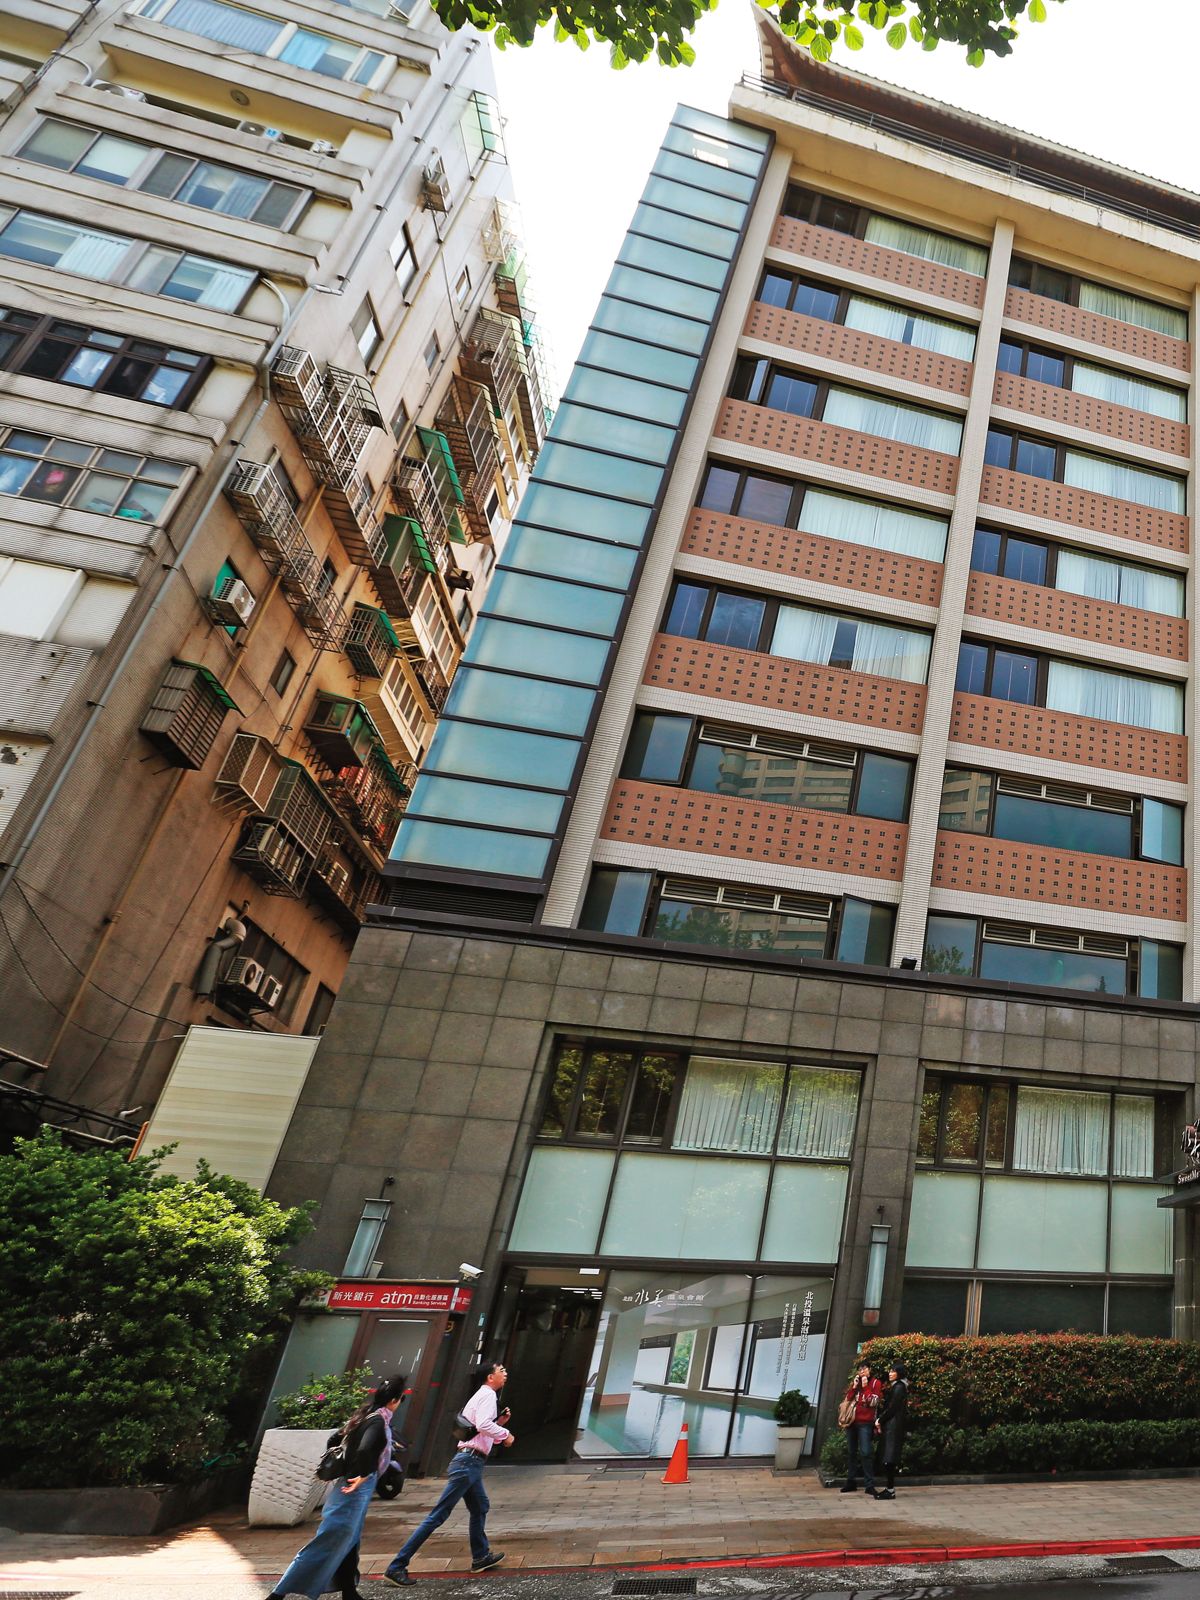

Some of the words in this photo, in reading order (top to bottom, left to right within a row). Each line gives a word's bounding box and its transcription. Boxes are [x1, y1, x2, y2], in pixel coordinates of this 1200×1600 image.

[1177, 1170, 1199, 1184] SweetMe
[332, 1291, 375, 1302] 新光銀行
[380, 1291, 412, 1305] atm
